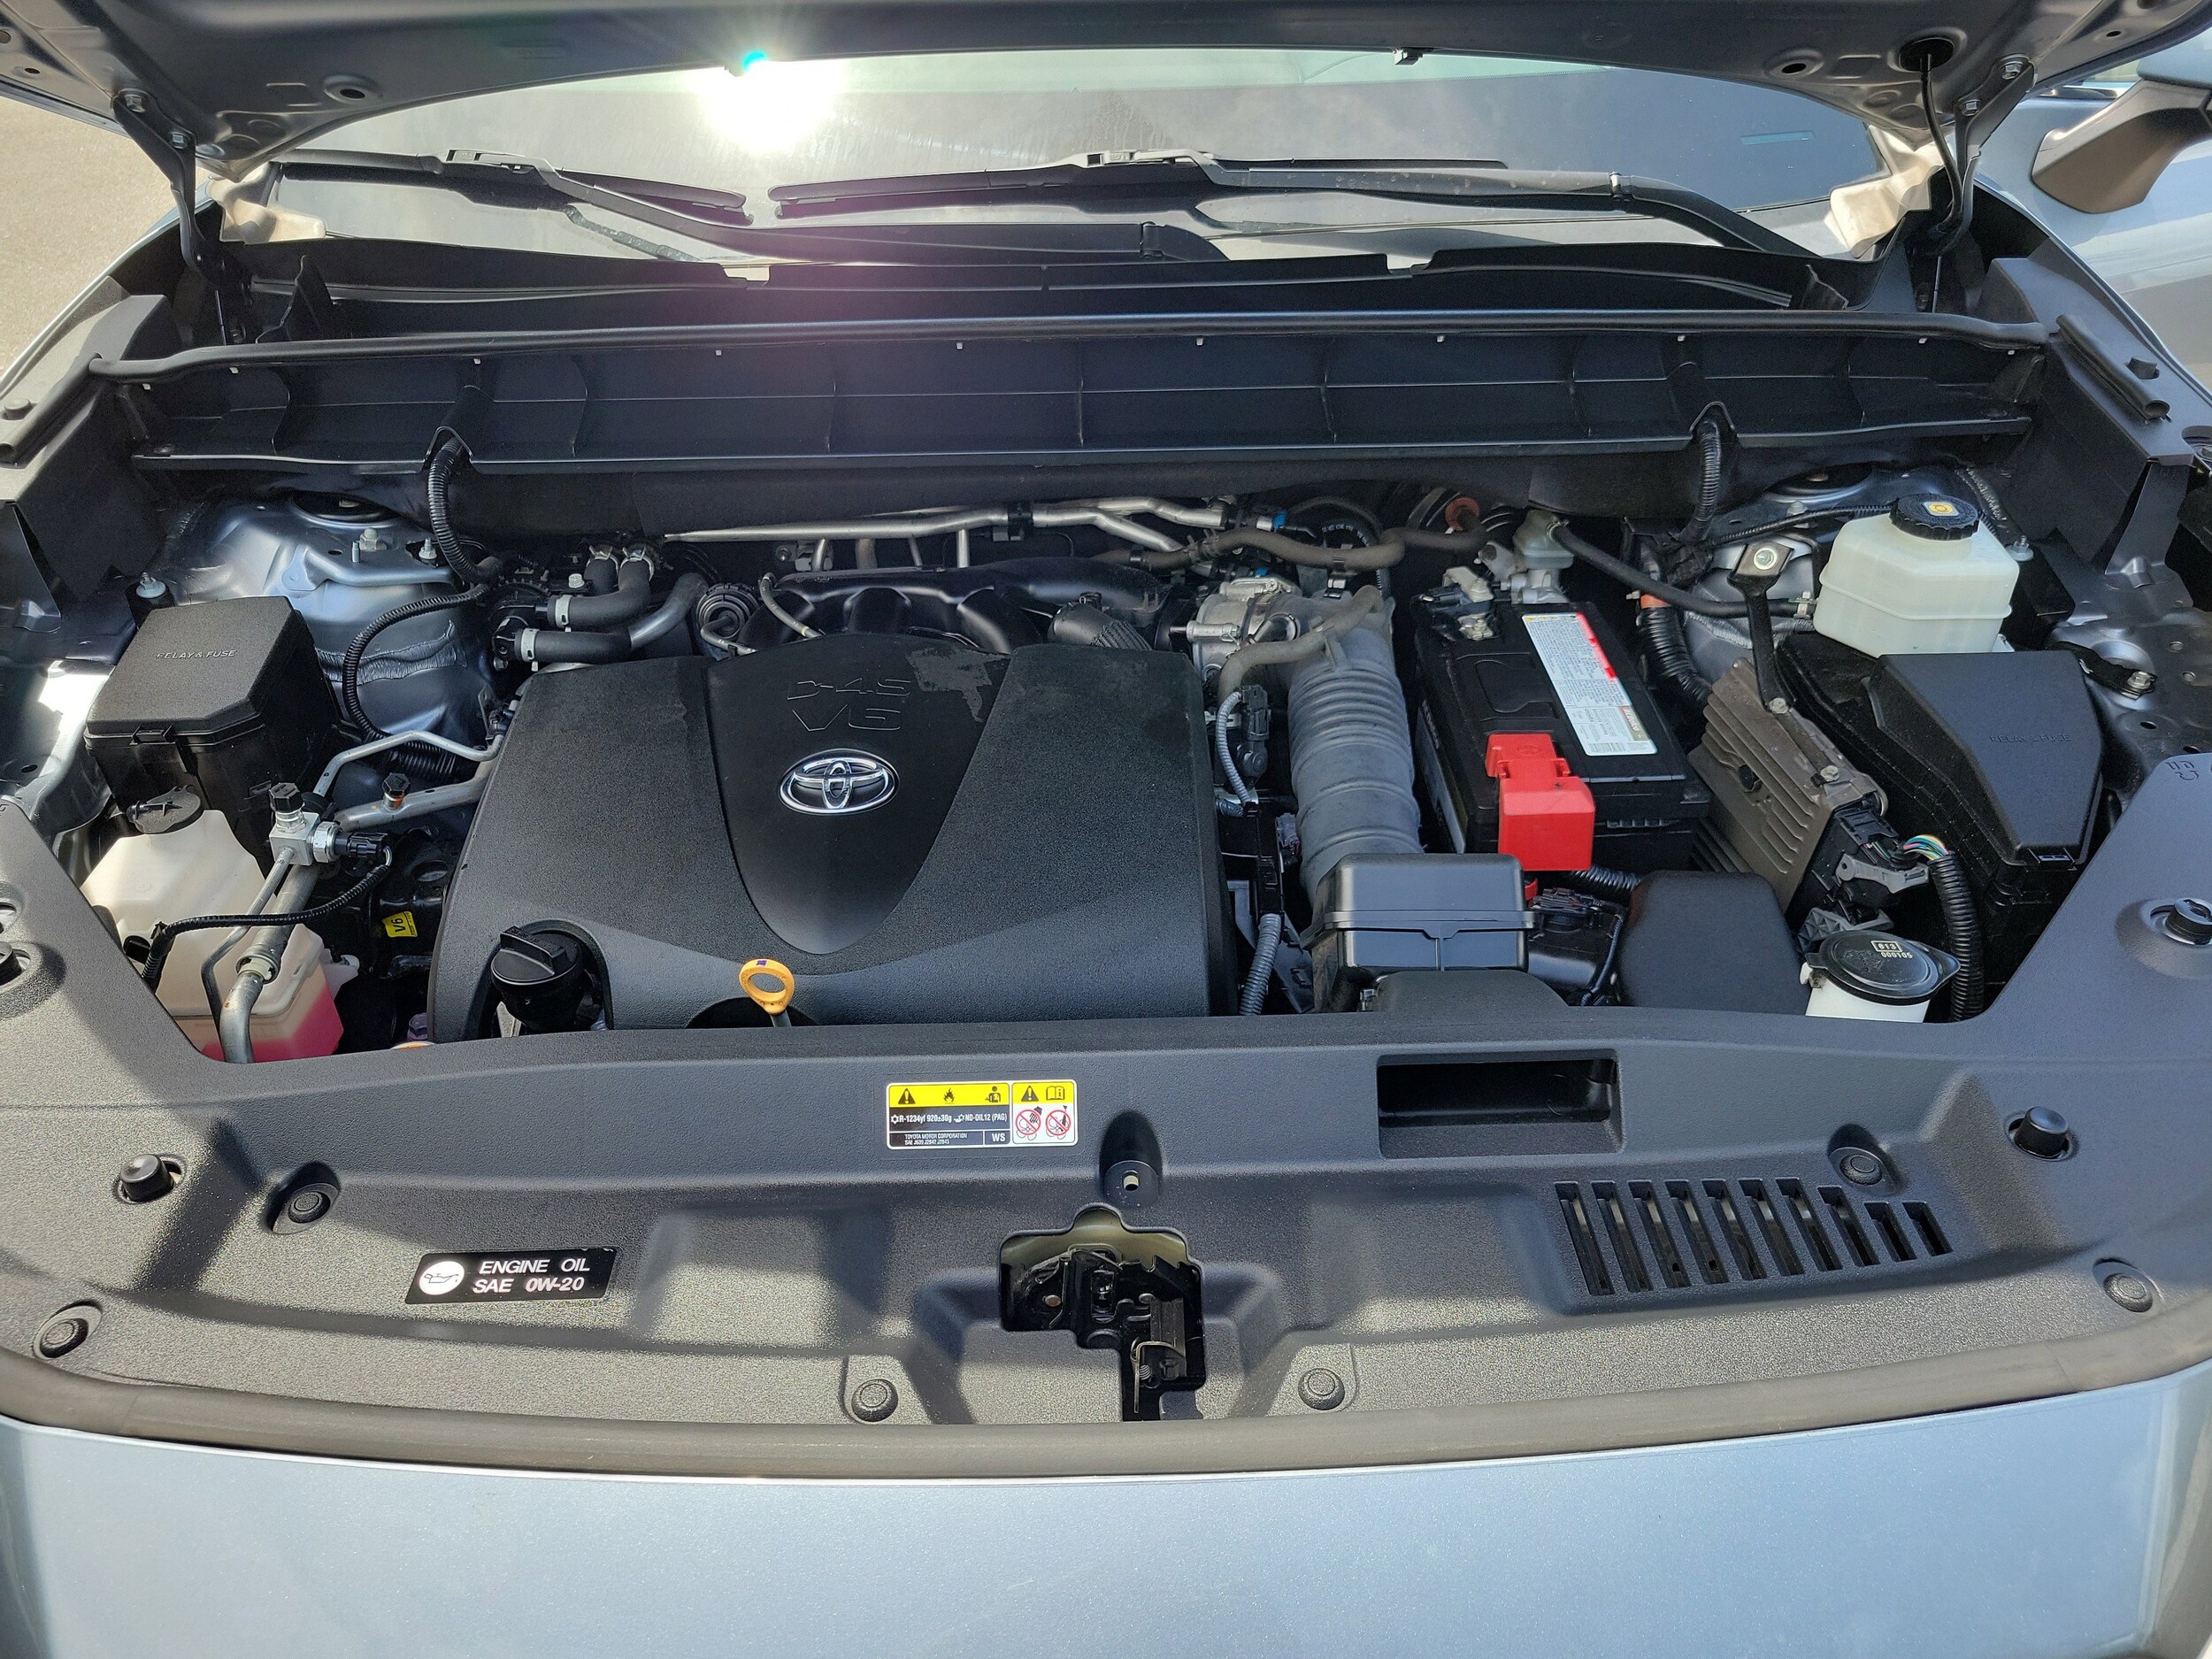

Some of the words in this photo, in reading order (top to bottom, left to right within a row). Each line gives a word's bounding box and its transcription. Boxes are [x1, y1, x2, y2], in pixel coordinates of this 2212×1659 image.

[206, 649, 237, 658] FUSE
[391, 918, 406, 933] V6
[899, 1114, 926, 1125] R-1234yf
[965, 1113, 991, 1122] ND-OIL12
[992, 1113, 1008, 1123] (PAG)
[991, 1133, 1006, 1142] WS
[479, 1259, 550, 1274] ENGINE
[560, 1258, 591, 1272] OIL
[472, 1279, 514, 1294] SAE
[525, 1277, 585, 1292] 0W-20
